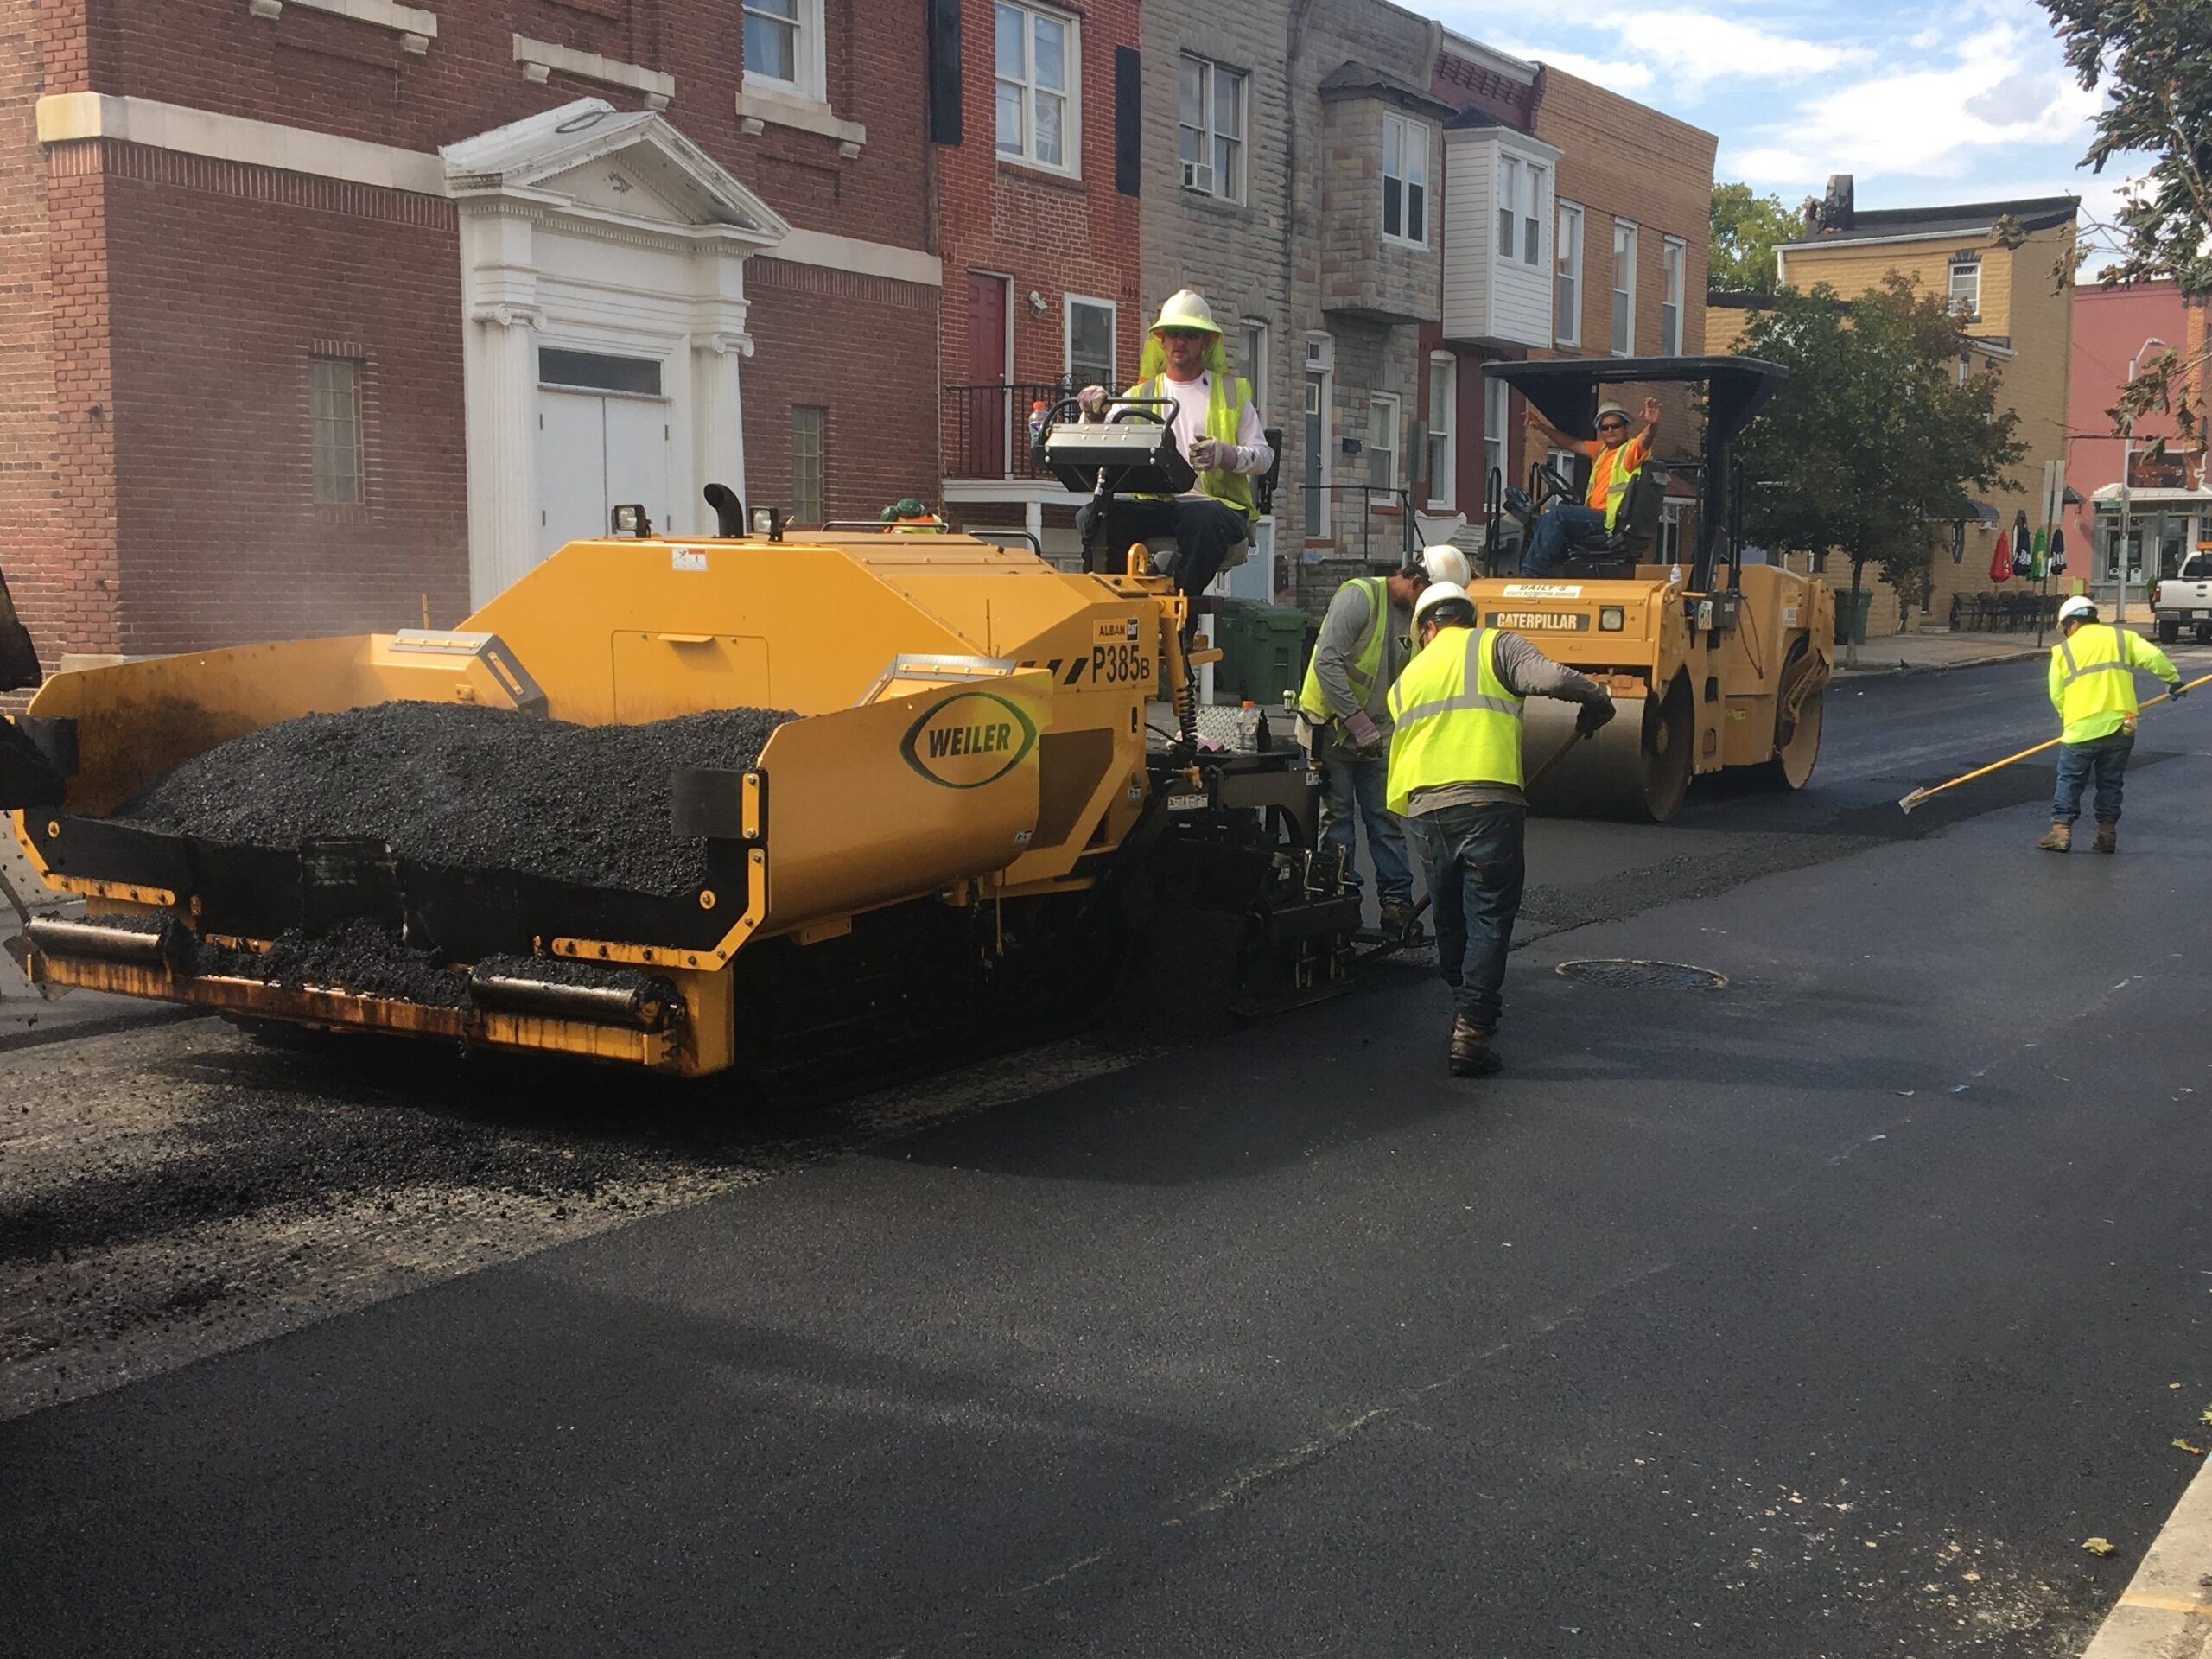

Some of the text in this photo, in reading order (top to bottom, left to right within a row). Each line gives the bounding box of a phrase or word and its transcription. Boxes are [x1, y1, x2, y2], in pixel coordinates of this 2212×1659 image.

[1099, 625, 1126, 637] ALBAN
[1497, 613, 1577, 630] CATERPILLAR
[1092, 645, 1151, 683] P385B
[929, 723, 1011, 758] WEILER
